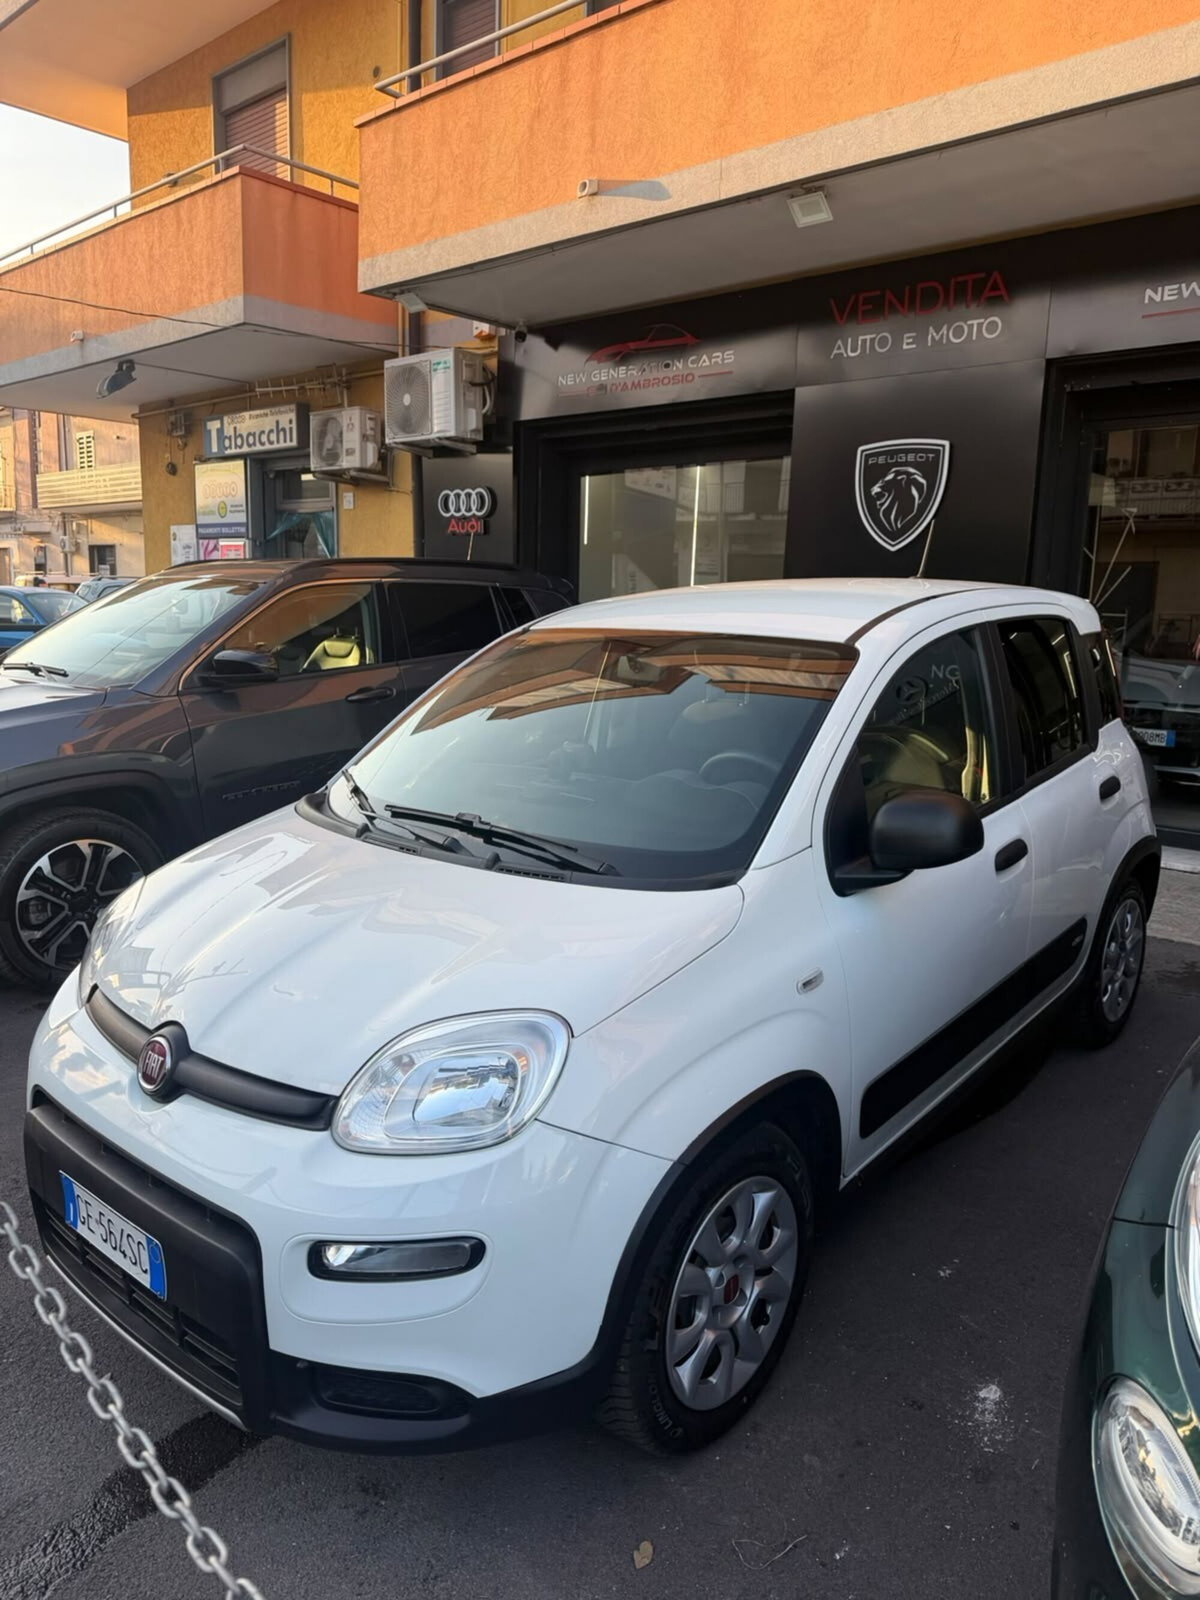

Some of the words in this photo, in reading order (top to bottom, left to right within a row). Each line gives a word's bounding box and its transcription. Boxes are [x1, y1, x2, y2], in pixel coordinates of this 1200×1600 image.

[830, 271, 1012, 326] VENDITA
[1144, 281, 1200, 304] NEW
[830, 332, 892, 359] AUTO
[902, 333, 917, 350] E
[927, 316, 1002, 346] MOTO
[558, 372, 587, 386] NEW
[591, 359, 684, 381] GENERATION
[687, 351, 735, 368] CARS
[609, 372, 696, 393] D'AMBROSIO
[206, 418, 295, 453] Tabacchi
[868, 453, 935, 465] PEUGEOT
[447, 517, 485, 534] Audi
[143, 1050, 164, 1079] FIAT
[98, 1210, 149, 1274] 564SC
